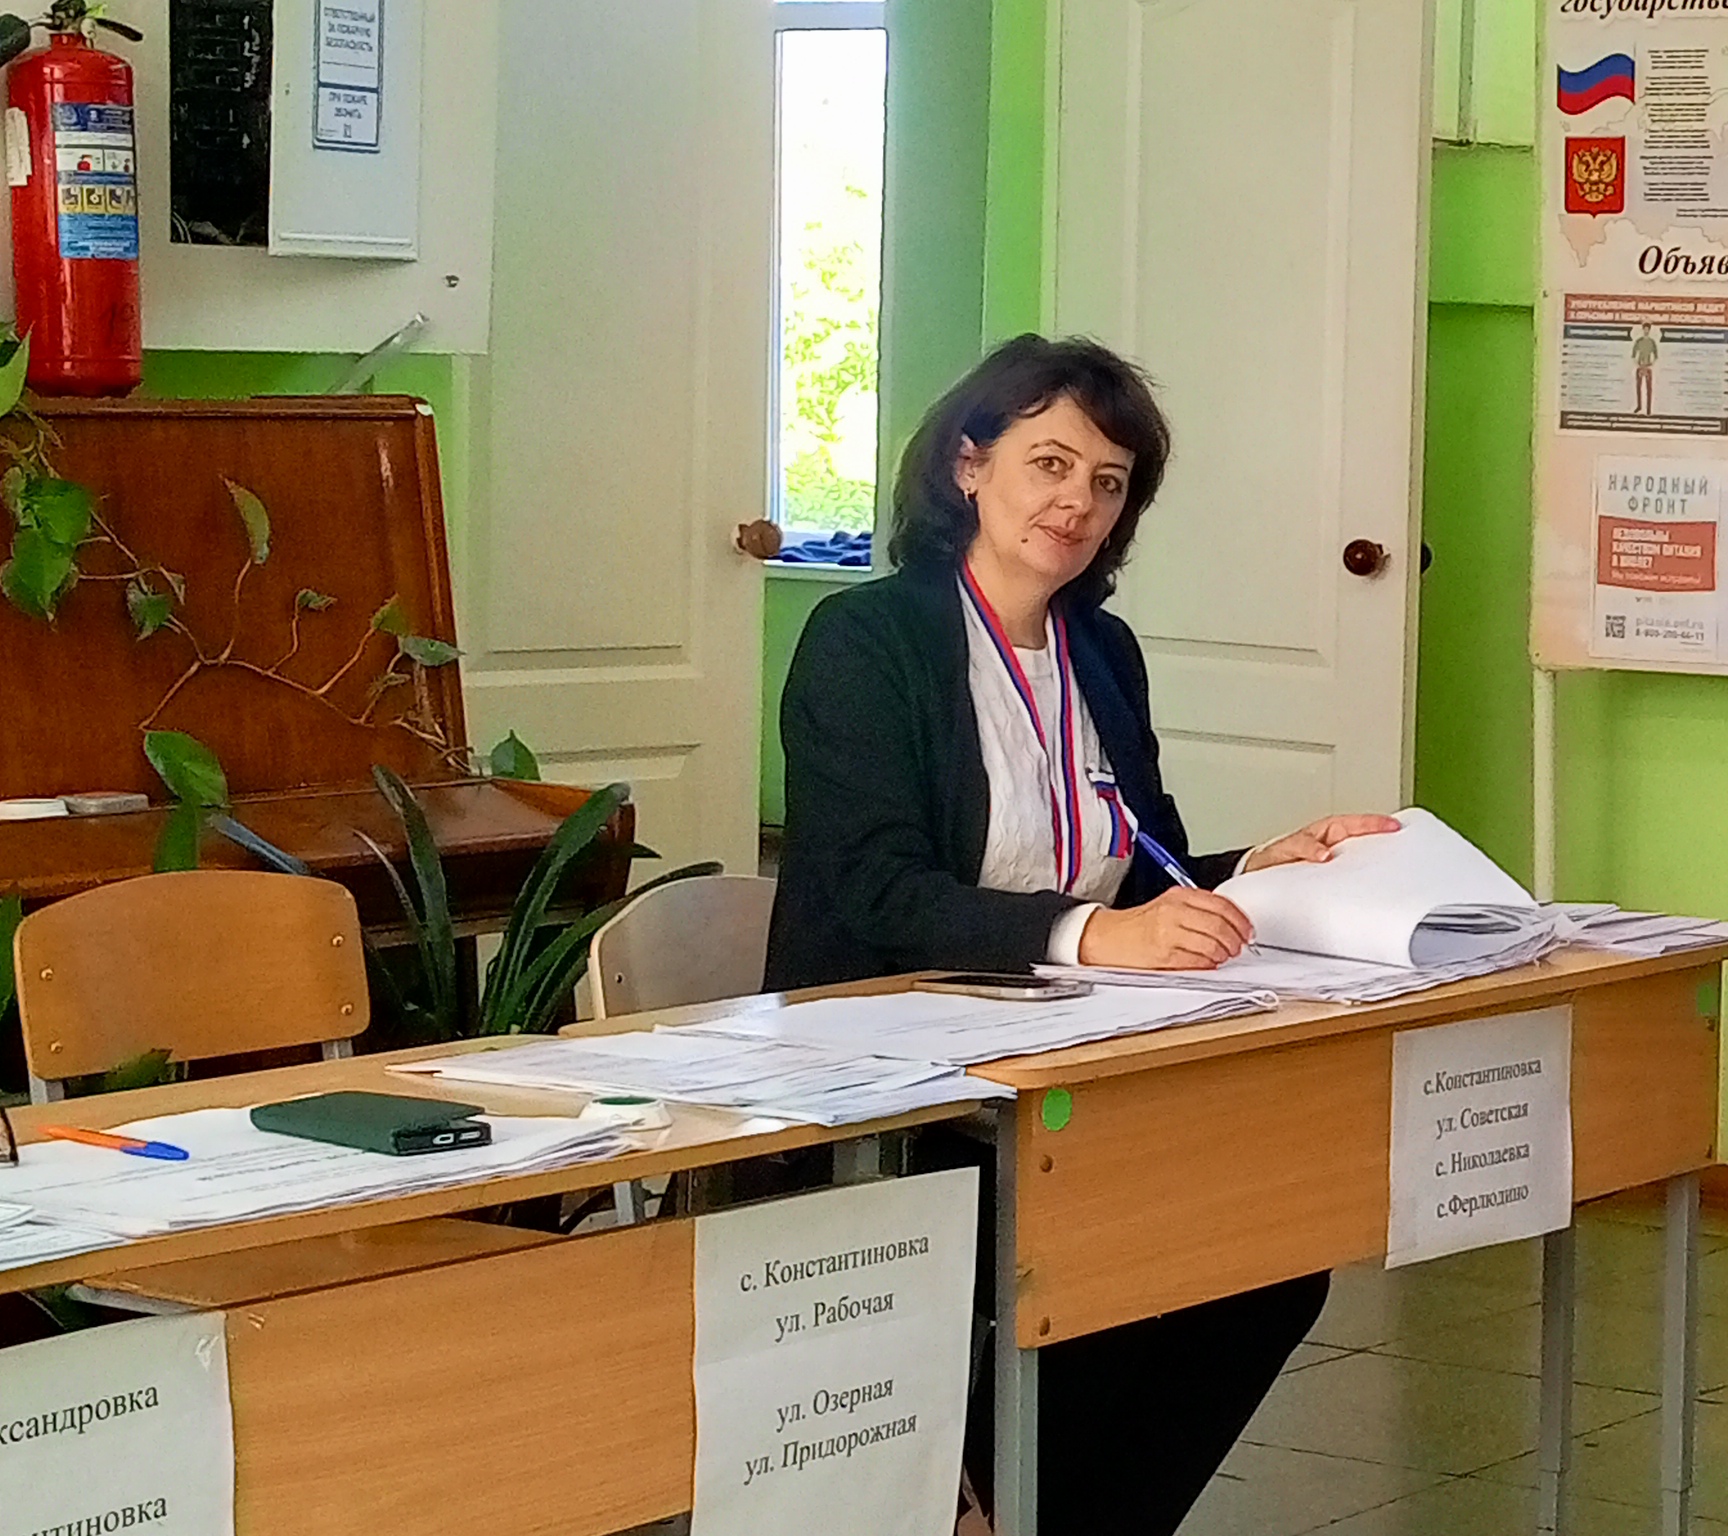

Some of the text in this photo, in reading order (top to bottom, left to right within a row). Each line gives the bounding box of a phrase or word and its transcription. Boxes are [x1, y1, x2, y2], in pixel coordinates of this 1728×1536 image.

[1607, 473, 1709, 496] НАРОДНЫЙ
[1627, 495, 1689, 515] ФРОНТ
[1436, 1102, 1529, 1140] ул. Советская
[1435, 1142, 1530, 1177] с. Николаевка
[739, 1235, 930, 1292] с. Константиновка
[774, 1292, 895, 1343] ул. Рабочая
[776, 1377, 894, 1434] ул. Озерная
[743, 1413, 918, 1486] ул. Придорожная
